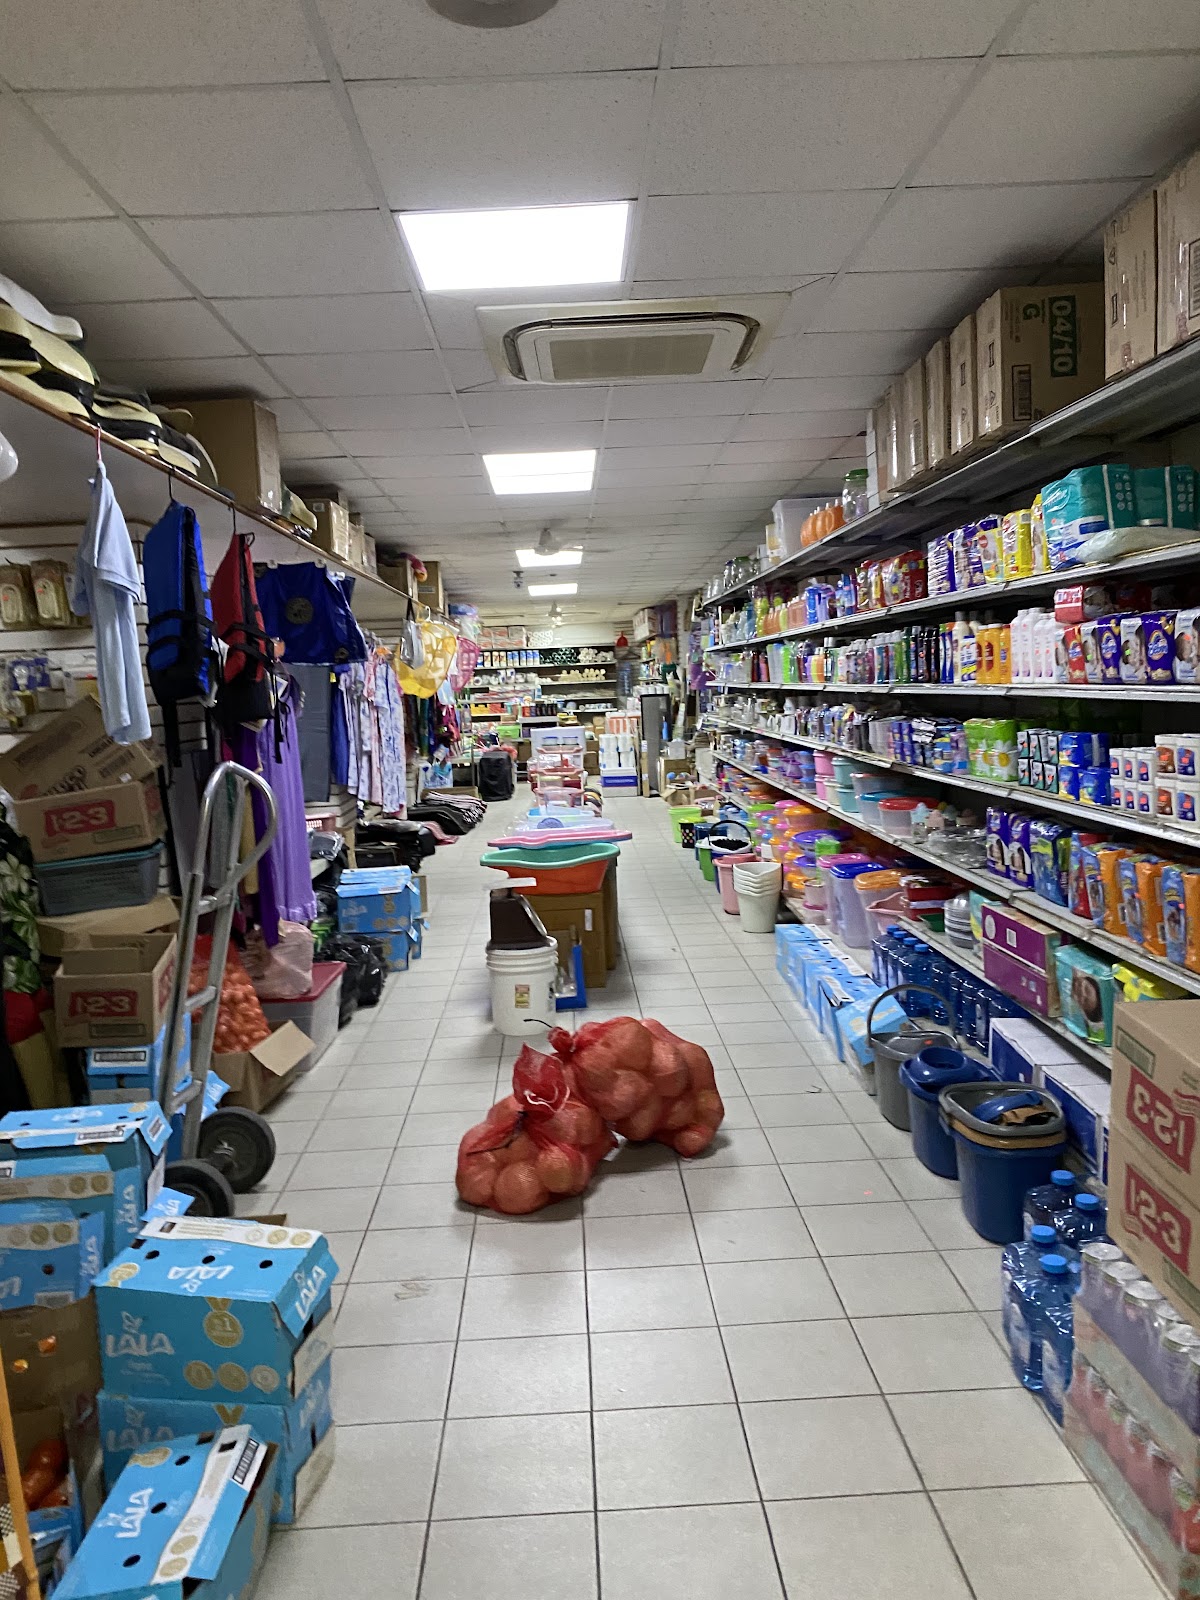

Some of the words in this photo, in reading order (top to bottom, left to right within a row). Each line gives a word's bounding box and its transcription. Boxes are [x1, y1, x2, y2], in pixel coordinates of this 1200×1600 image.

[1051, 300, 1074, 373] 04/10
[166, 1265, 235, 1281] LALA
[295, 1265, 328, 1321] LALA
[105, 1332, 175, 1357] LALA
